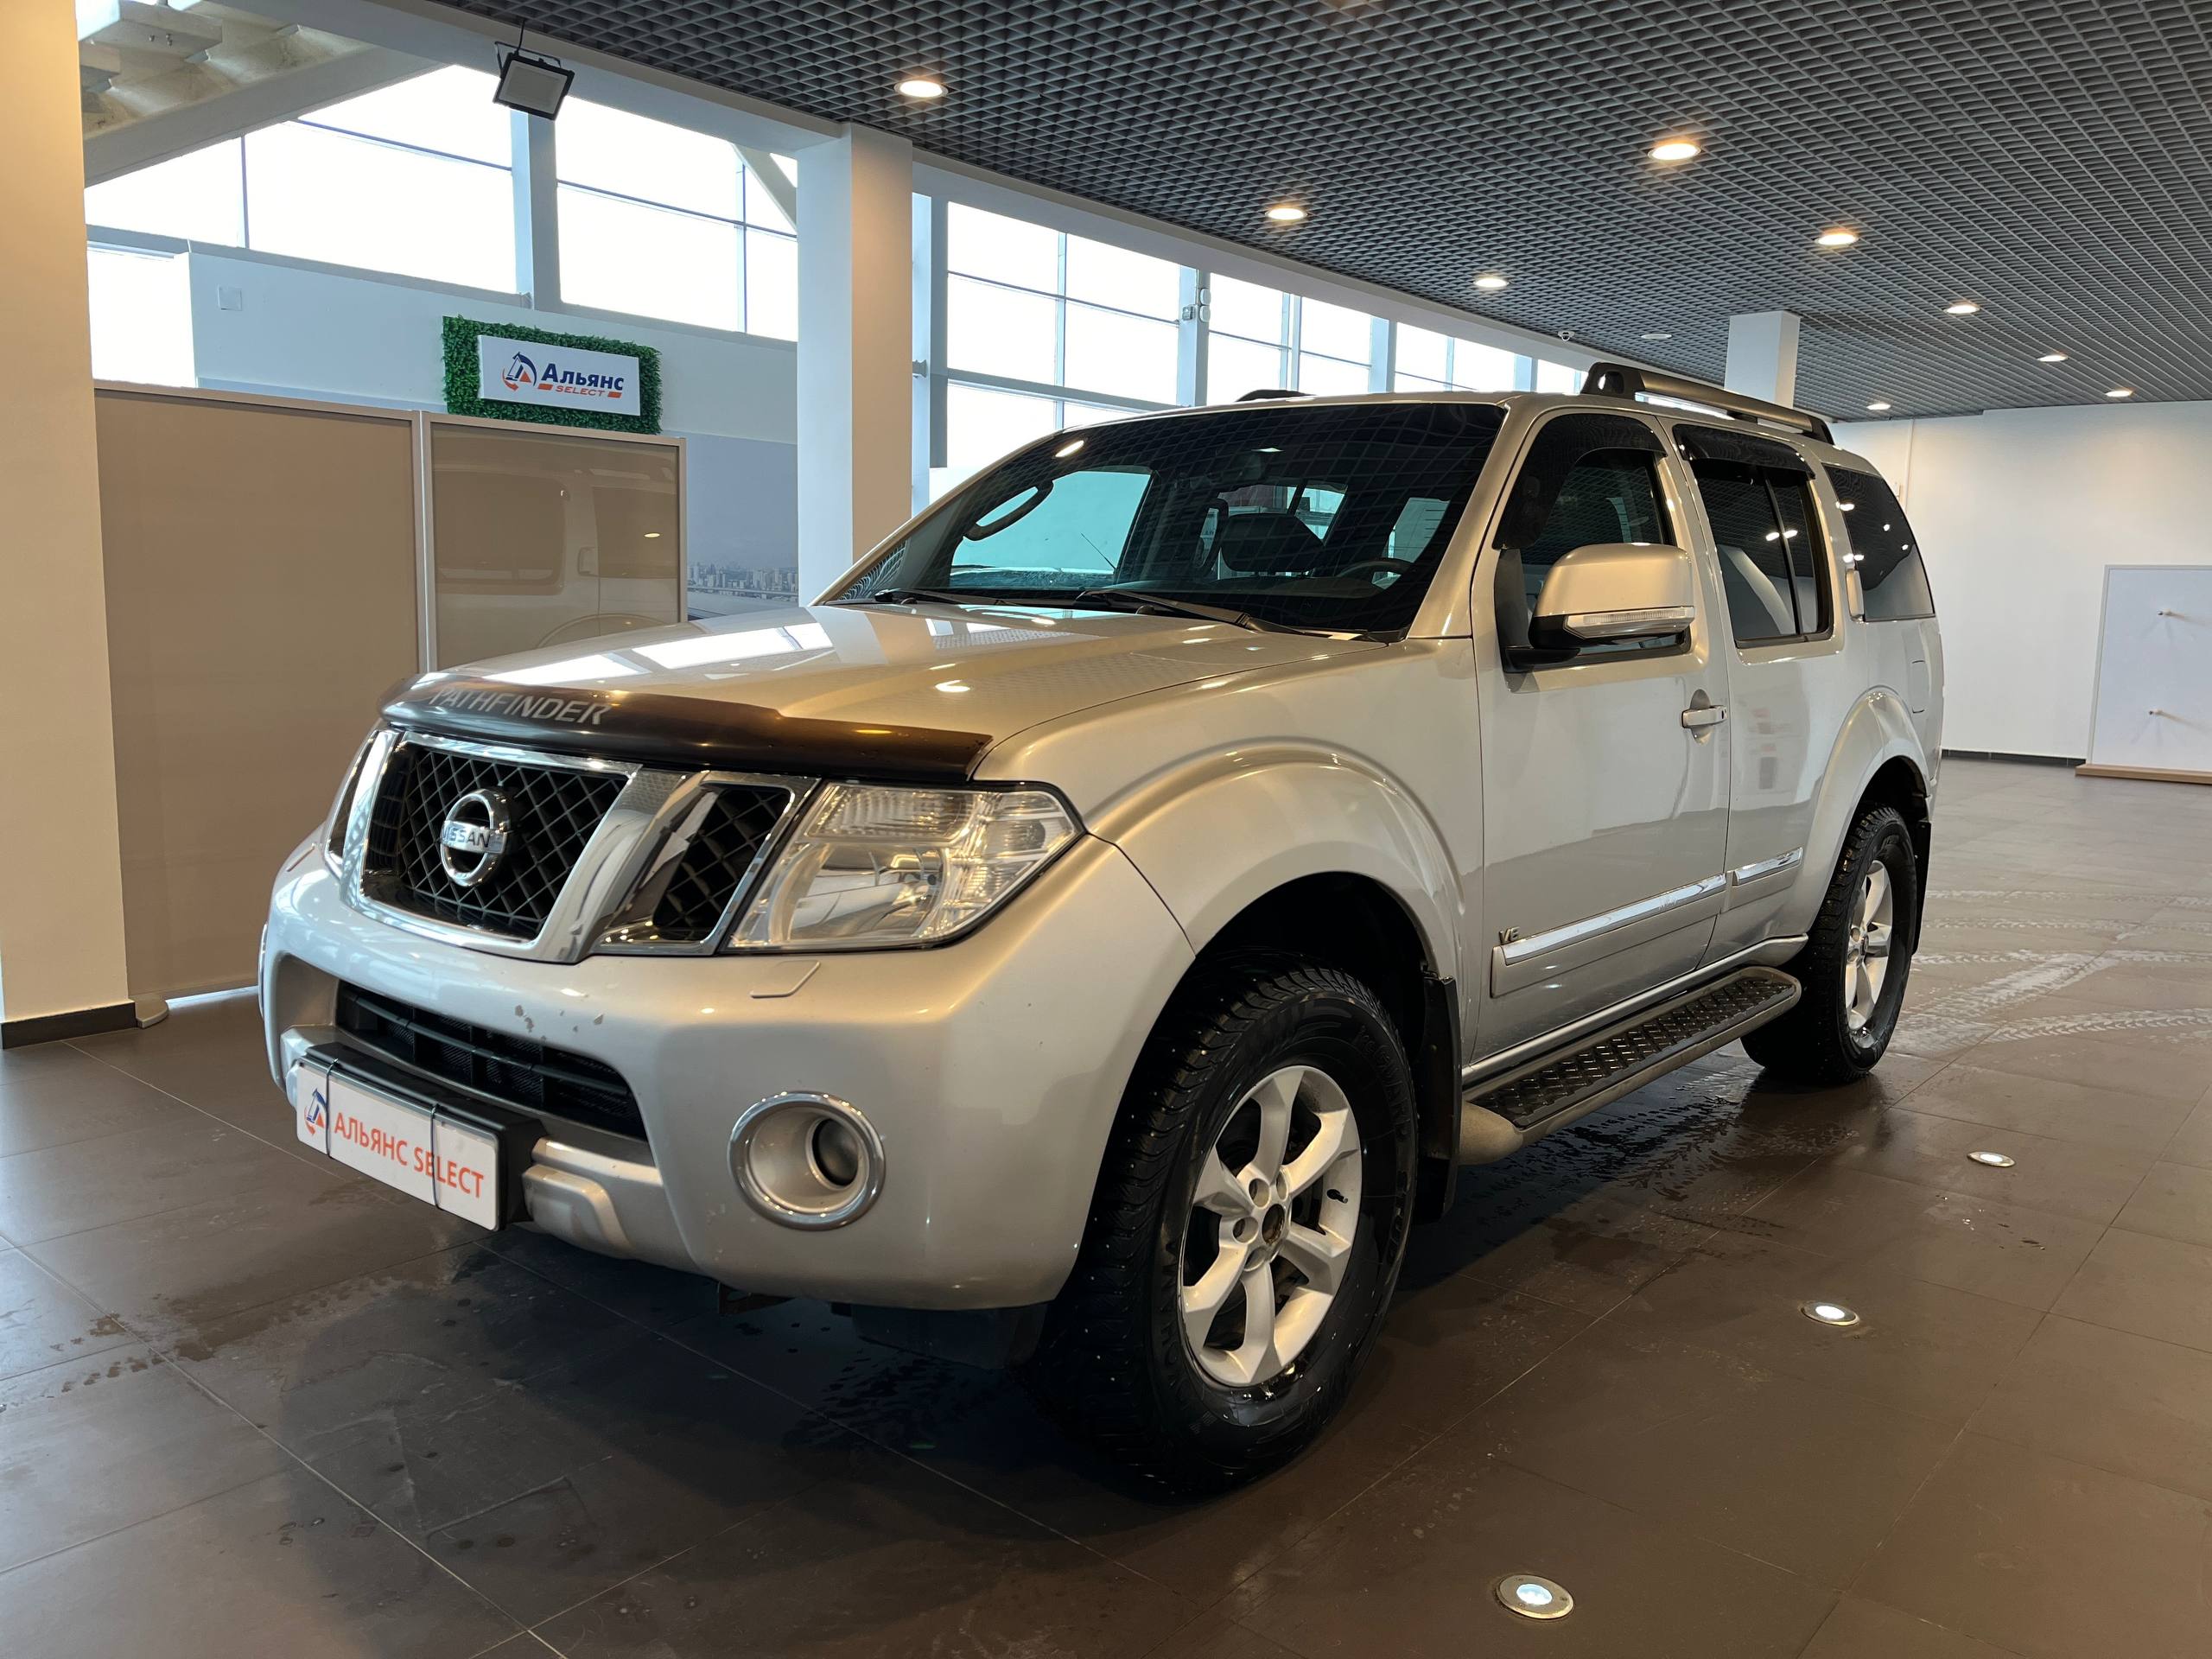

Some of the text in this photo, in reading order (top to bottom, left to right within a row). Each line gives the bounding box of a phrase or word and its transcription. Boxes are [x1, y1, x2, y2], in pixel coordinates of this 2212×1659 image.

[540, 363, 625, 391] Альянс
[555, 385, 606, 397] SELECT
[429, 688, 612, 726] PATHFINDER
[442, 827, 492, 849] NISSAN
[334, 1111, 485, 1199] АЛЬЯНС SELECT
